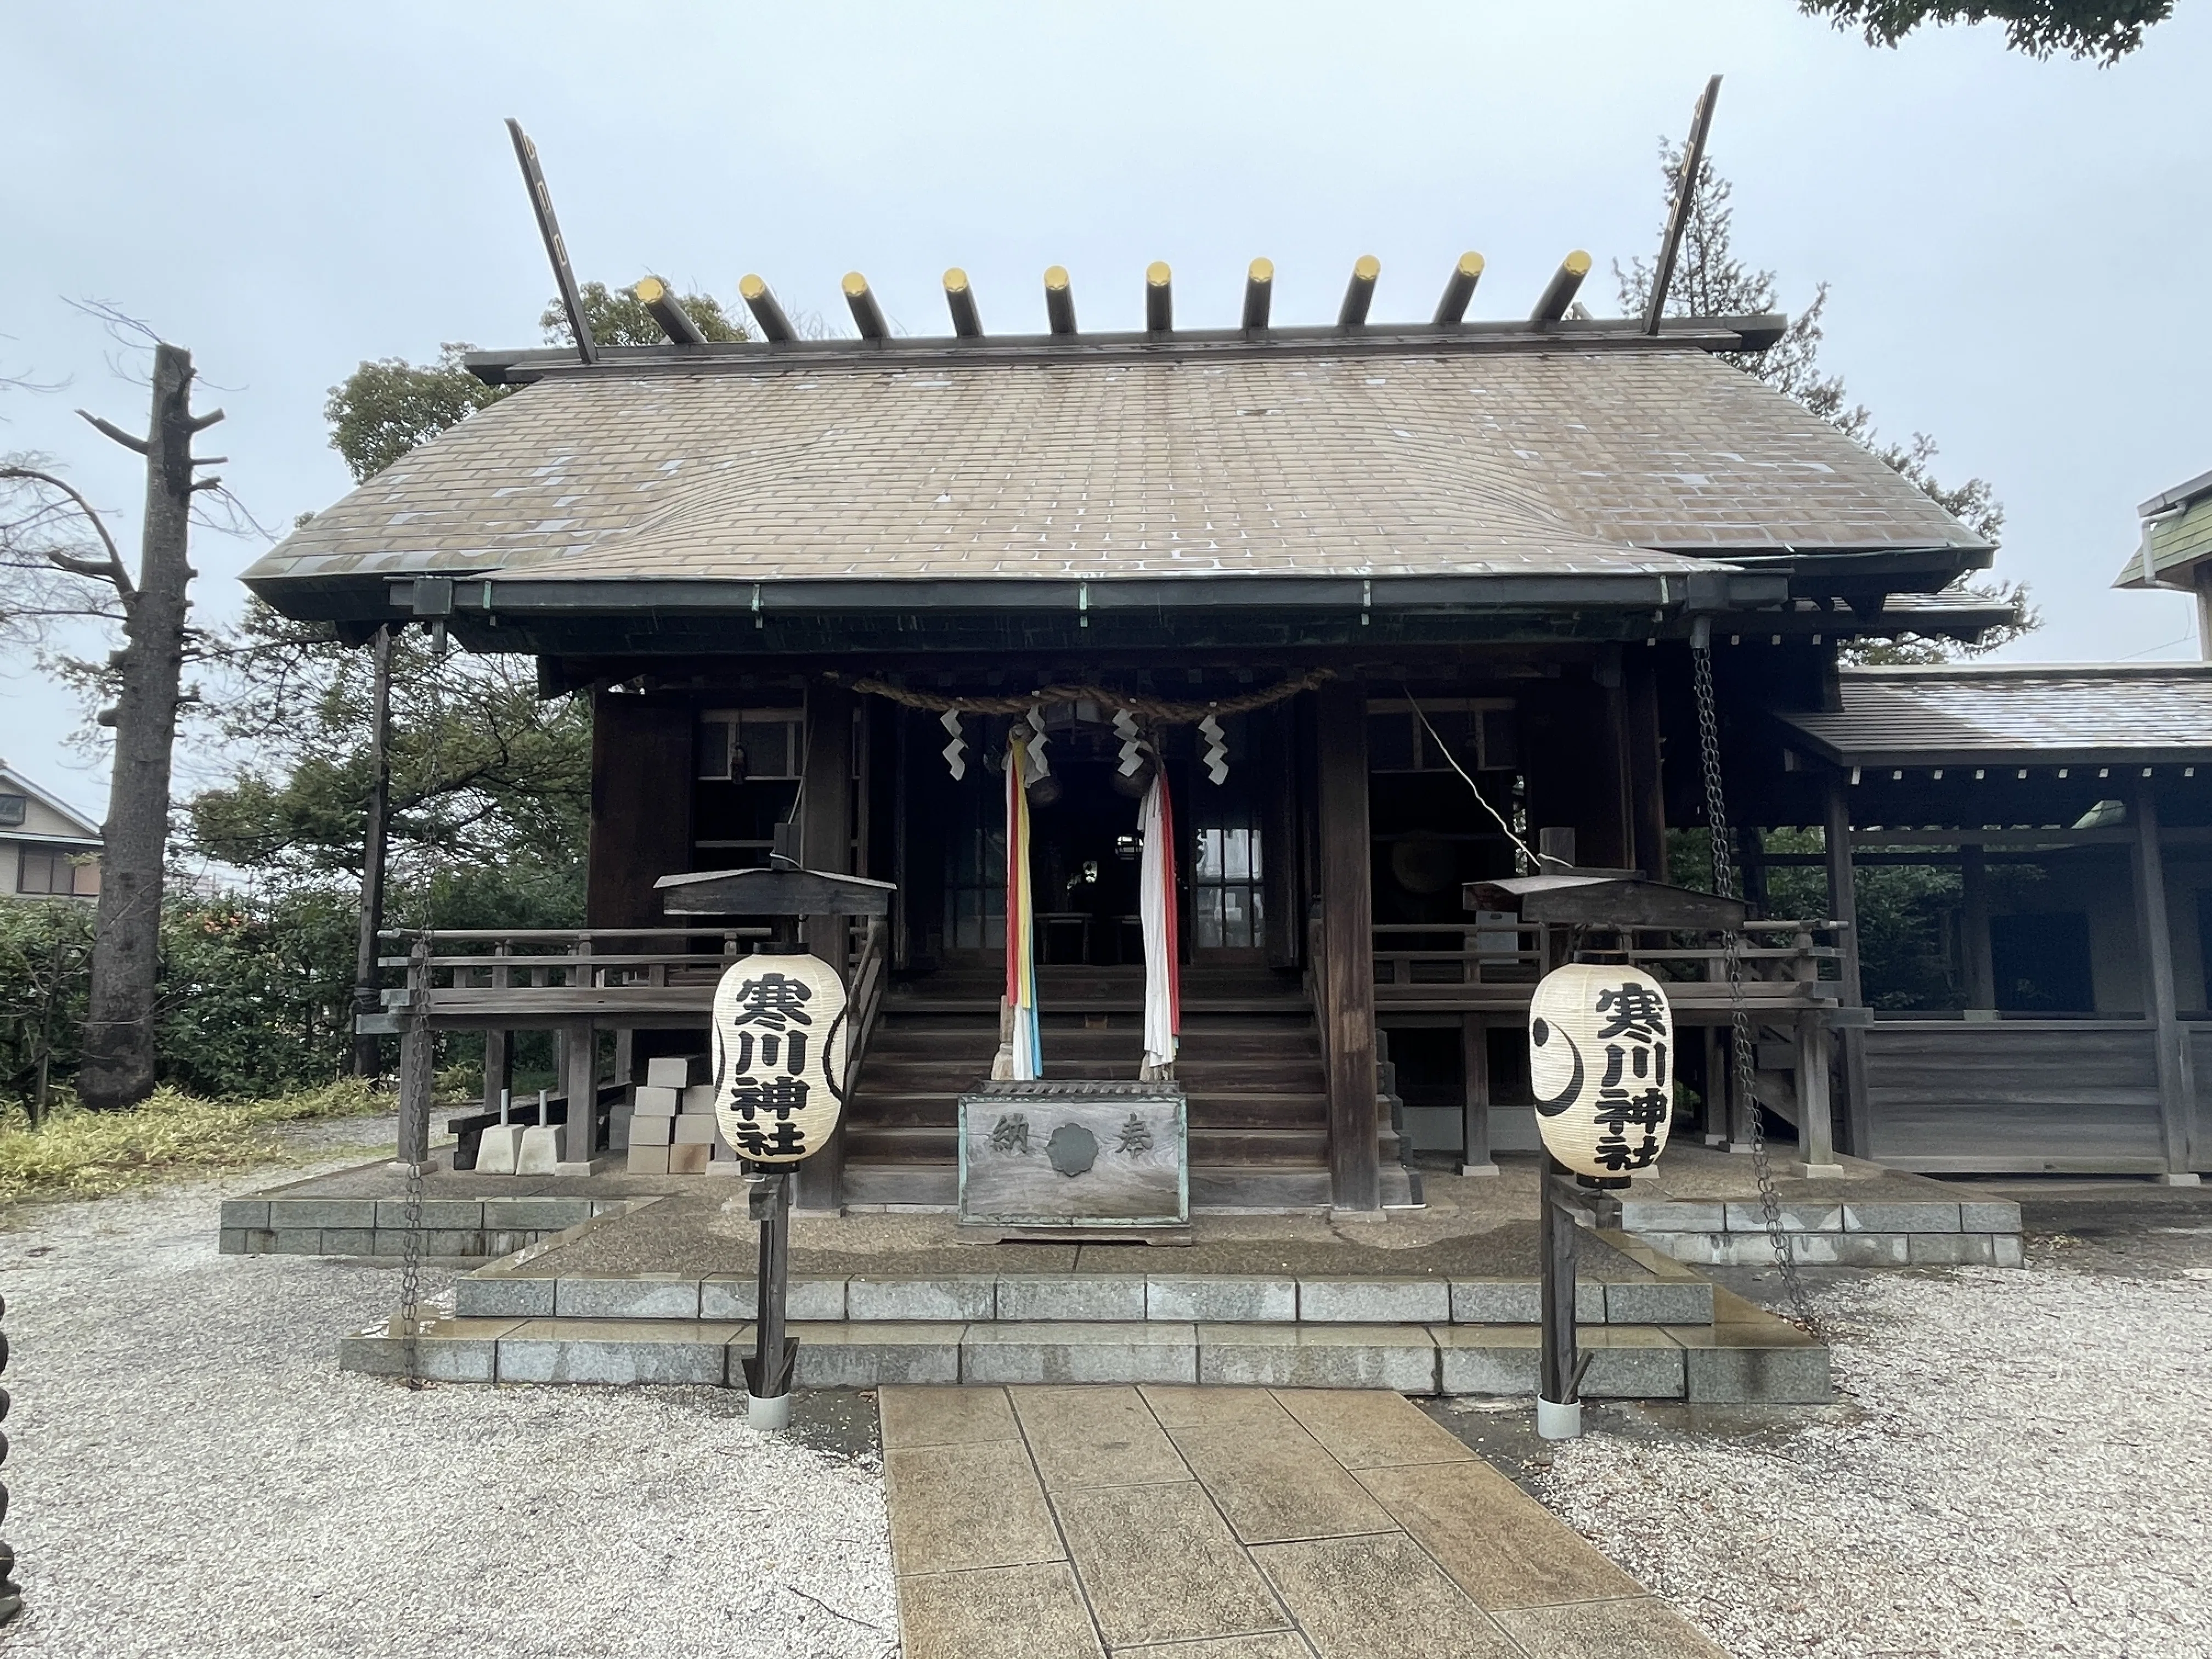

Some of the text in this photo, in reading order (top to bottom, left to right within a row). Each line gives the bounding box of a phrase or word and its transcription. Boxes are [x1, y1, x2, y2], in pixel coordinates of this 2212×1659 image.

[730, 972, 812, 1156] 寒川神社
[1593, 982, 1667, 1171] 寒川神社
